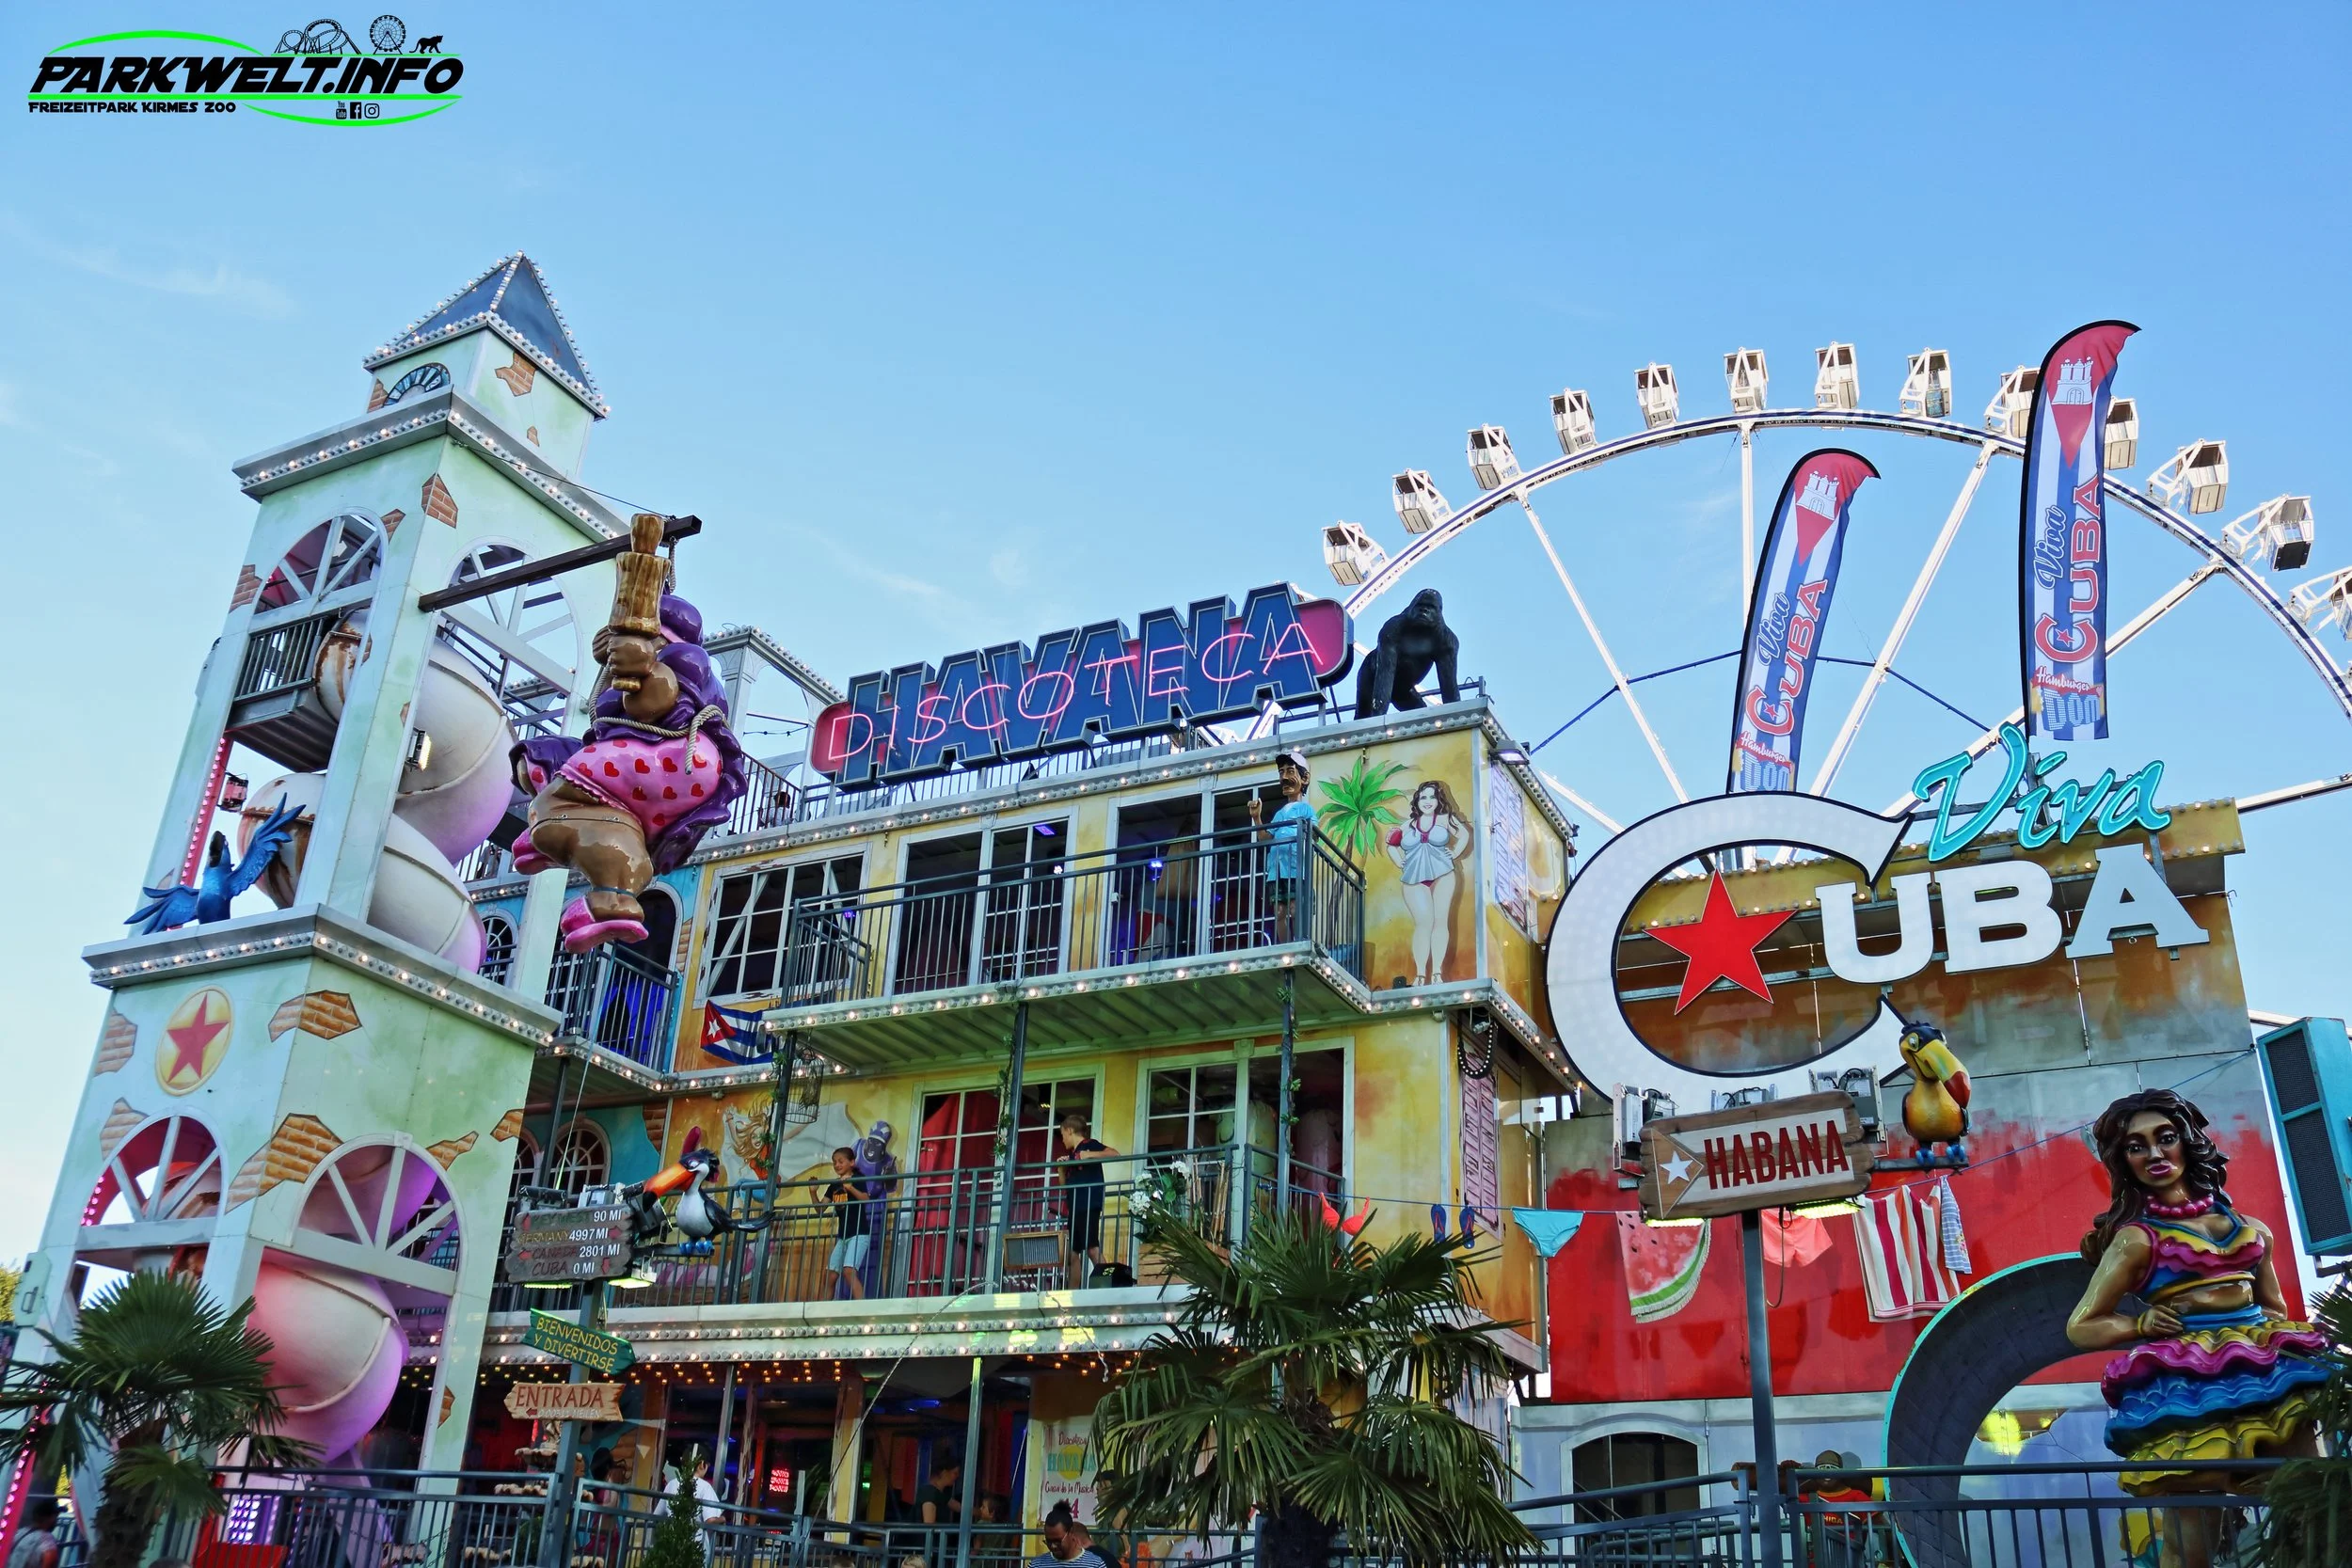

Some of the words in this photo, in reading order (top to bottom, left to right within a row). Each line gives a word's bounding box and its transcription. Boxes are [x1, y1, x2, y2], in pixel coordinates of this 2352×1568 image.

[2033, 504, 2067, 590] Viva
[2034, 473, 2102, 664] CUBA
[1756, 591, 1790, 667] Viva
[1745, 578, 1829, 736] CUBA
[2036, 666, 2090, 693] Hamburger
[827, 622, 1325, 762] DISCOTECA
[835, 581, 1327, 793] HAVANA
[1740, 731, 1787, 763] Hamburger
[1912, 721, 2171, 863] Viva
[1546, 790, 2210, 1119] CUBA
[1704, 1119, 1850, 1190] HABANA
[518, 1230, 568, 1243] GERMANY
[569, 1229, 595, 1241] 4997
[596, 1227, 609, 1239] MI
[594, 1211, 606, 1222] 90
[609, 1210, 622, 1221] MI
[532, 1261, 568, 1275] CUBA
[582, 1262, 595, 1274] MI
[580, 1246, 604, 1258] 2801
[608, 1243, 620, 1256] MI
[536, 1317, 618, 1354] BIENVENIDOS
[543, 1337, 615, 1373] DIVERTIRSE
[516, 1386, 604, 1408] ENTRADA
